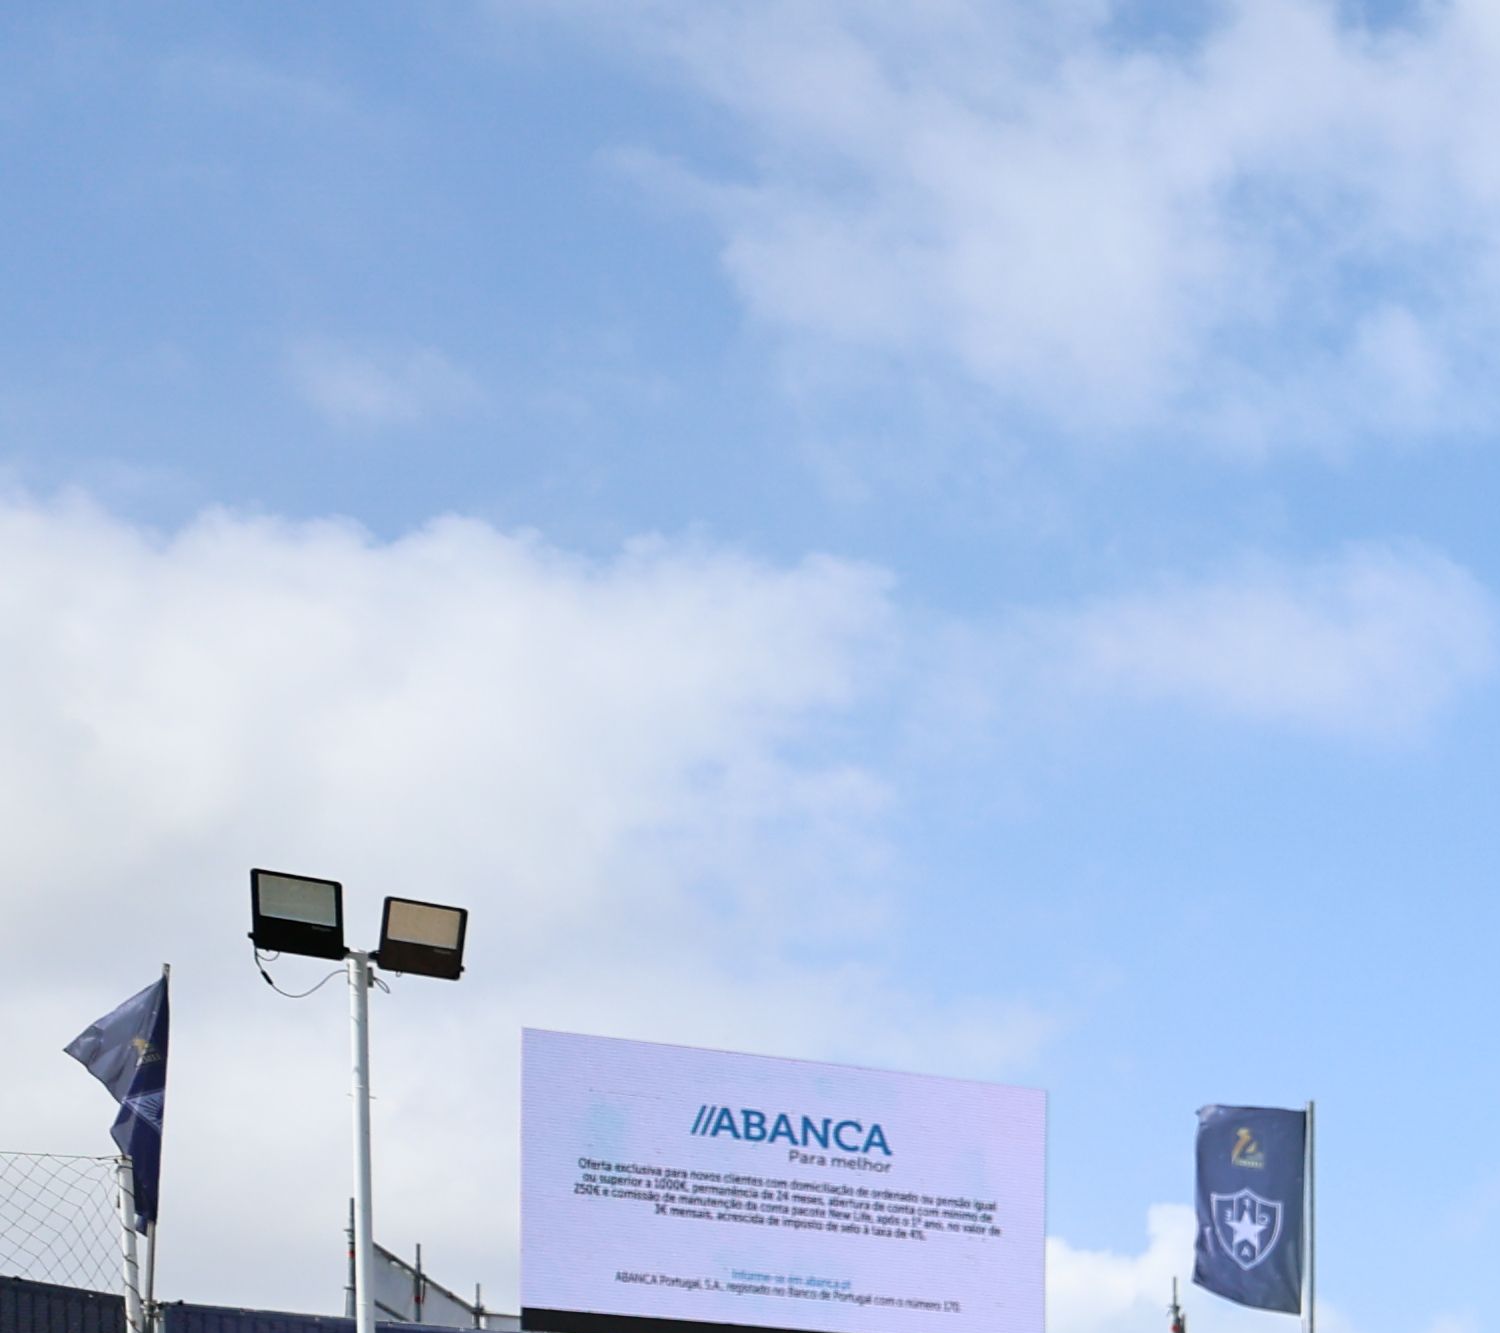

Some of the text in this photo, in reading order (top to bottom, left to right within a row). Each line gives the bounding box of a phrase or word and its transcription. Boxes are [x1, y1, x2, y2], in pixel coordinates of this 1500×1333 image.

[788, 1149, 891, 1173] Para melhor
[616, 1272, 657, 1284] ABANCA
